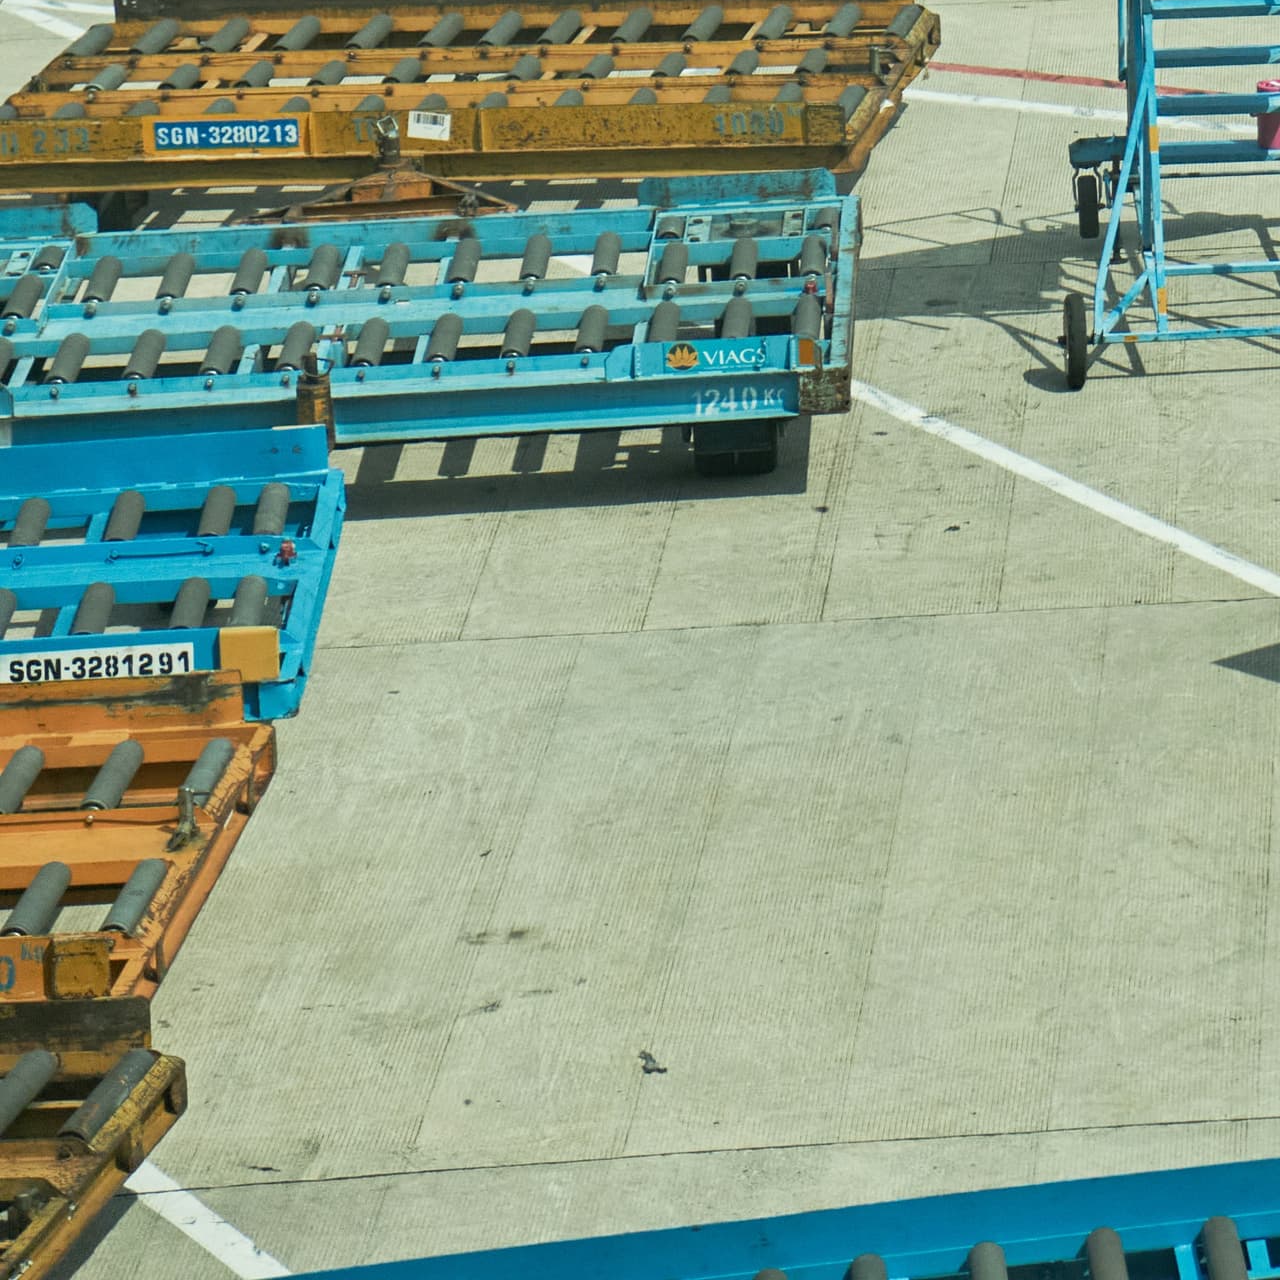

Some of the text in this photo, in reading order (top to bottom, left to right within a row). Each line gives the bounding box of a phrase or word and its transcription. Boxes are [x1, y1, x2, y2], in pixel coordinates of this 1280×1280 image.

[156, 121, 299, 146] SGN-3280213
[702, 348, 766, 366] VIAGS
[692, 386, 758, 416] 1240
[10, 651, 190, 682] SGN-3281291
